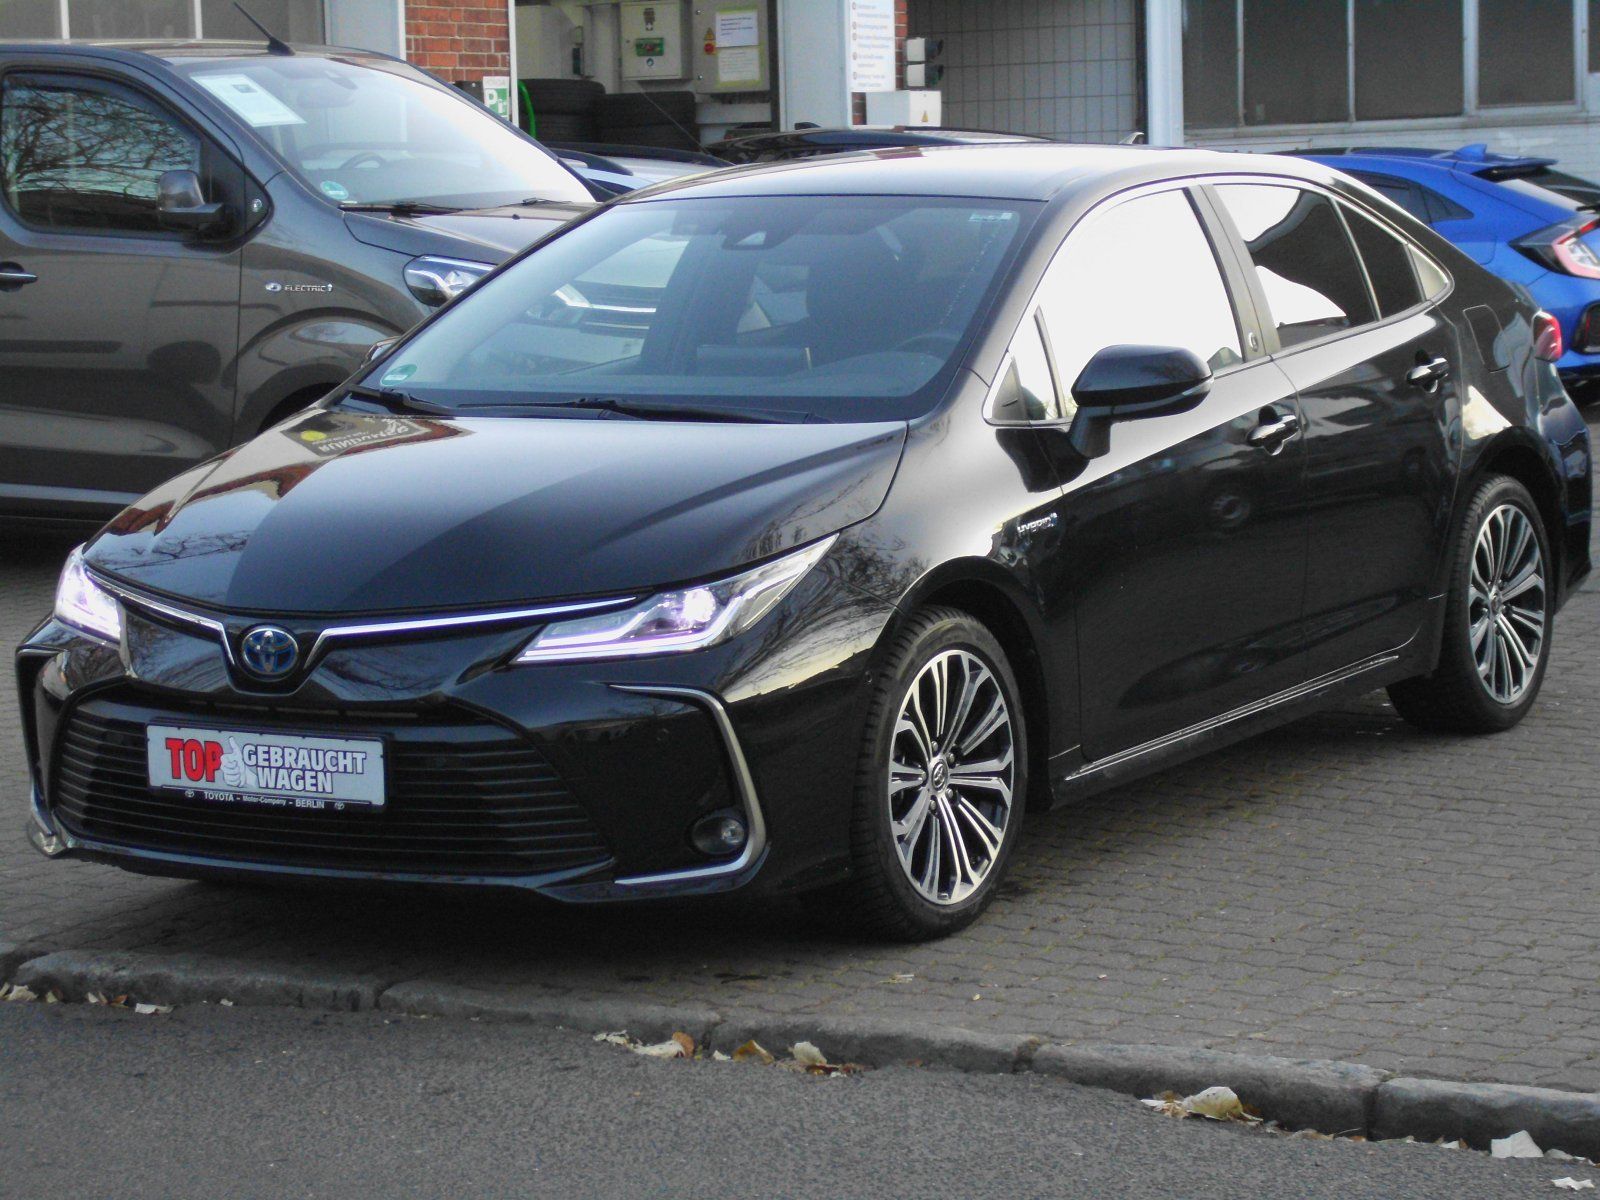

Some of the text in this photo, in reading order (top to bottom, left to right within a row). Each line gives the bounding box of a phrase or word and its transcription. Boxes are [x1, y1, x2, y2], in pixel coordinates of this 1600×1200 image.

[284, 284, 326, 293] ELECTRIC
[165, 737, 224, 783] TOP
[242, 743, 367, 775] GEBRAUCHT
[257, 765, 334, 794] WAGEN
[203, 791, 235, 803] TOYOTA
[295, 800, 326, 810] BERLIN
